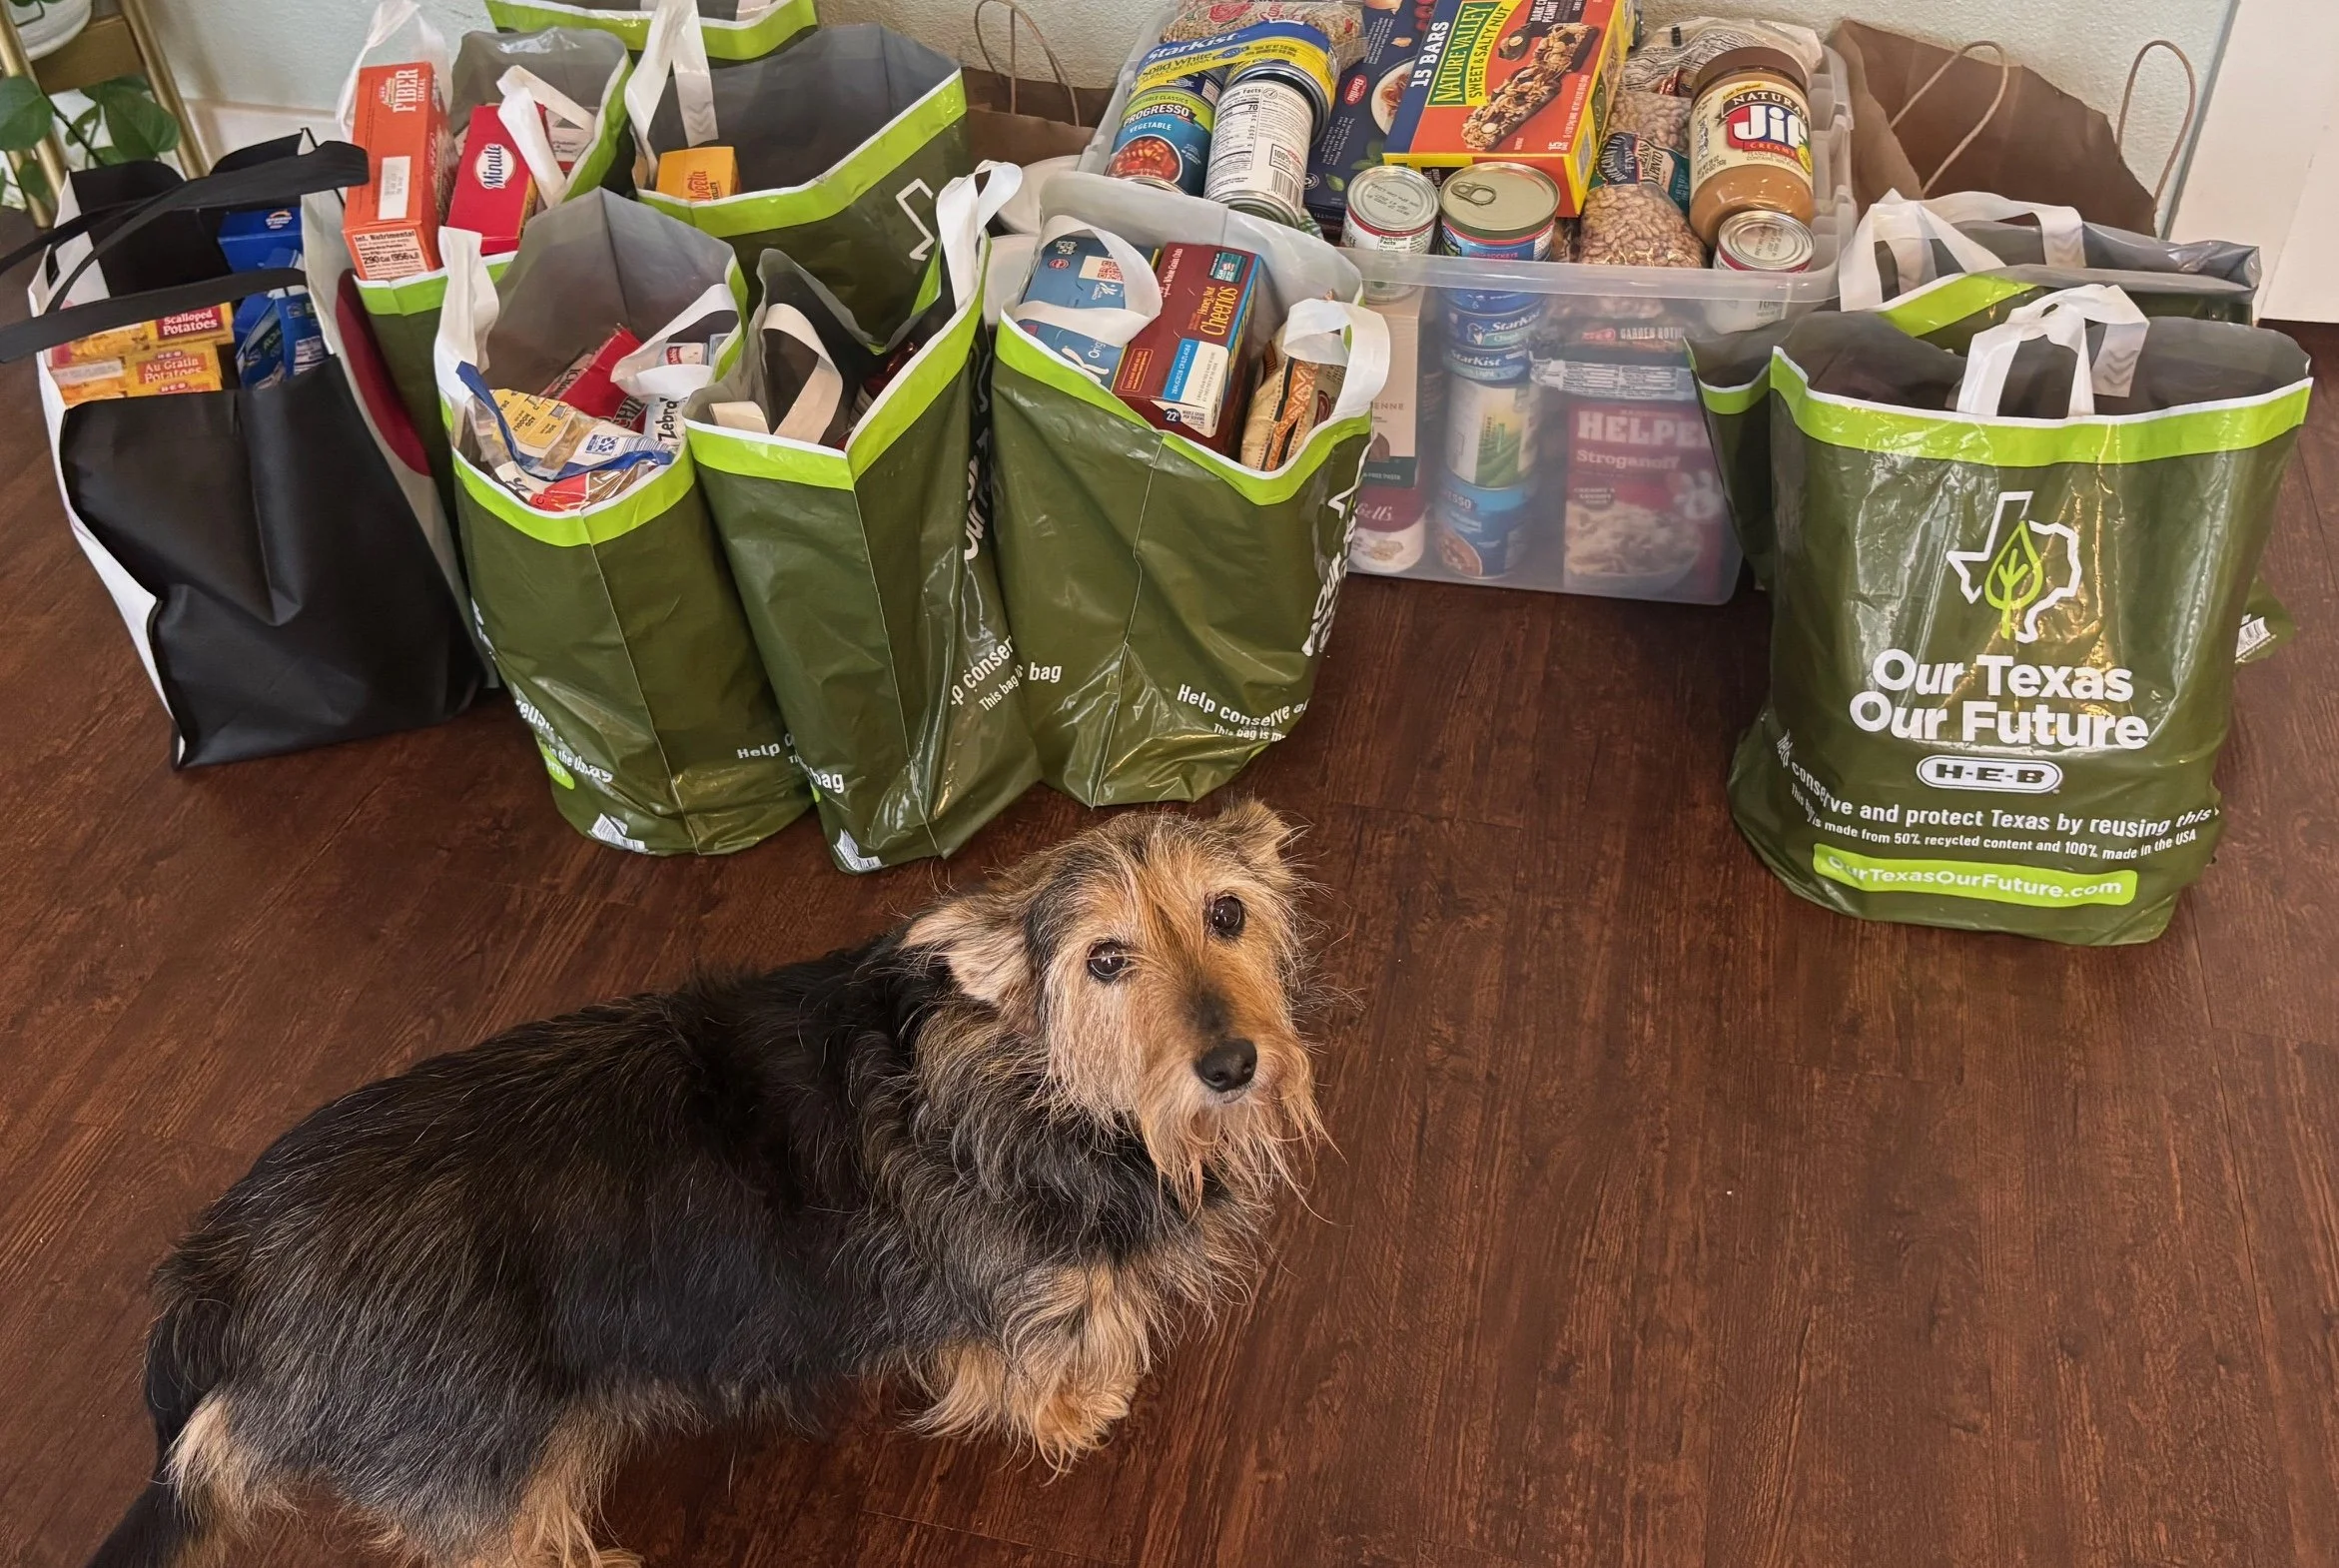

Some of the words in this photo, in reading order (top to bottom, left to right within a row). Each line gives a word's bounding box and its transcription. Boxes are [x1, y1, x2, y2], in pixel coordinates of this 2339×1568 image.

[1491, 6, 1512, 29] NUT
[1530, 6, 1547, 22] DARK
[1148, 33, 1237, 60] StarKist
[1419, 21, 1450, 65] BARS
[1433, 46, 1468, 102] NATURE
[1454, 5, 1494, 49] VALLEY
[1475, 27, 1497, 57] SALTY
[1174, 52, 1212, 67] White
[1410, 69, 1432, 88] 15
[1468, 65, 1483, 98] SWEET
[392, 69, 418, 113] FIBER
[1347, 78, 1365, 104] Barilla
[1124, 103, 1190, 127] PROGRESSO
[1129, 121, 1171, 134] VEGETABLE
[1733, 105, 1809, 149] Jif
[1548, 140, 1562, 150] 15
[1749, 141, 1796, 157] CREAMY
[483, 144, 503, 188] Minute
[1649, 151, 1664, 180] PINTO
[687, 171, 712, 200] lveeta
[1203, 287, 1216, 299] Nut
[164, 310, 213, 326] Scalloped
[1197, 297, 1215, 316] Honey
[1199, 286, 1238, 336] Cheerios
[163, 319, 219, 336] Potatoes
[1491, 310, 1541, 332] StarKist
[1088, 340, 1107, 359] Orig
[1452, 350, 1500, 368] StarKist
[144, 369, 202, 384] Potatoes
[145, 363, 162, 374] Au
[165, 358, 199, 371] Gratin
[1373, 401, 1404, 410] ENNE
[656, 397, 679, 441] Zebra
[1576, 449, 1680, 469] Stroganoff
[963, 635, 1014, 692] conser
[1029, 662, 1062, 682] bag
[1873, 649, 1965, 695] Our
[1975, 654, 2134, 702] Texas
[979, 689, 1003, 712] This
[1001, 672, 1021, 696] bag
[1176, 683, 1216, 713] Help
[1219, 705, 1290, 727] conserve
[1850, 691, 1948, 740] Our
[1962, 701, 2149, 749] Future
[1213, 723, 1234, 736] This
[1236, 729, 1257, 741] bag
[1259, 730, 1268, 740] is
[558, 749, 572, 767] the
[737, 743, 781, 759] Help
[810, 768, 845, 794] bag
[1936, 763, 2045, 784] H-E-B
[1791, 761, 1854, 816] conserve
[1860, 804, 1900, 823] and
[1906, 809, 1983, 828] protect
[1990, 809, 2050, 831] Texas
[2056, 813, 2084, 835] by
[2089, 818, 2171, 838] reusing
[2175, 808, 2212, 828] this
[1791, 782, 1805, 806] This
[1825, 821, 1858, 838] made
[1861, 828, 1891, 844] from
[1894, 832, 1922, 846] 50%
[1925, 835, 1980, 848] recycled
[1983, 837, 2033, 851] content
[2035, 840, 2060, 853] and
[2064, 840, 2098, 858] 100%
[2101, 847, 2137, 860] made
[2140, 843, 2151, 857] in
[2154, 837, 2172, 852] the
[2175, 828, 2197, 846] USA
[1828, 855, 2123, 899] OurTexasOurFuture.com
